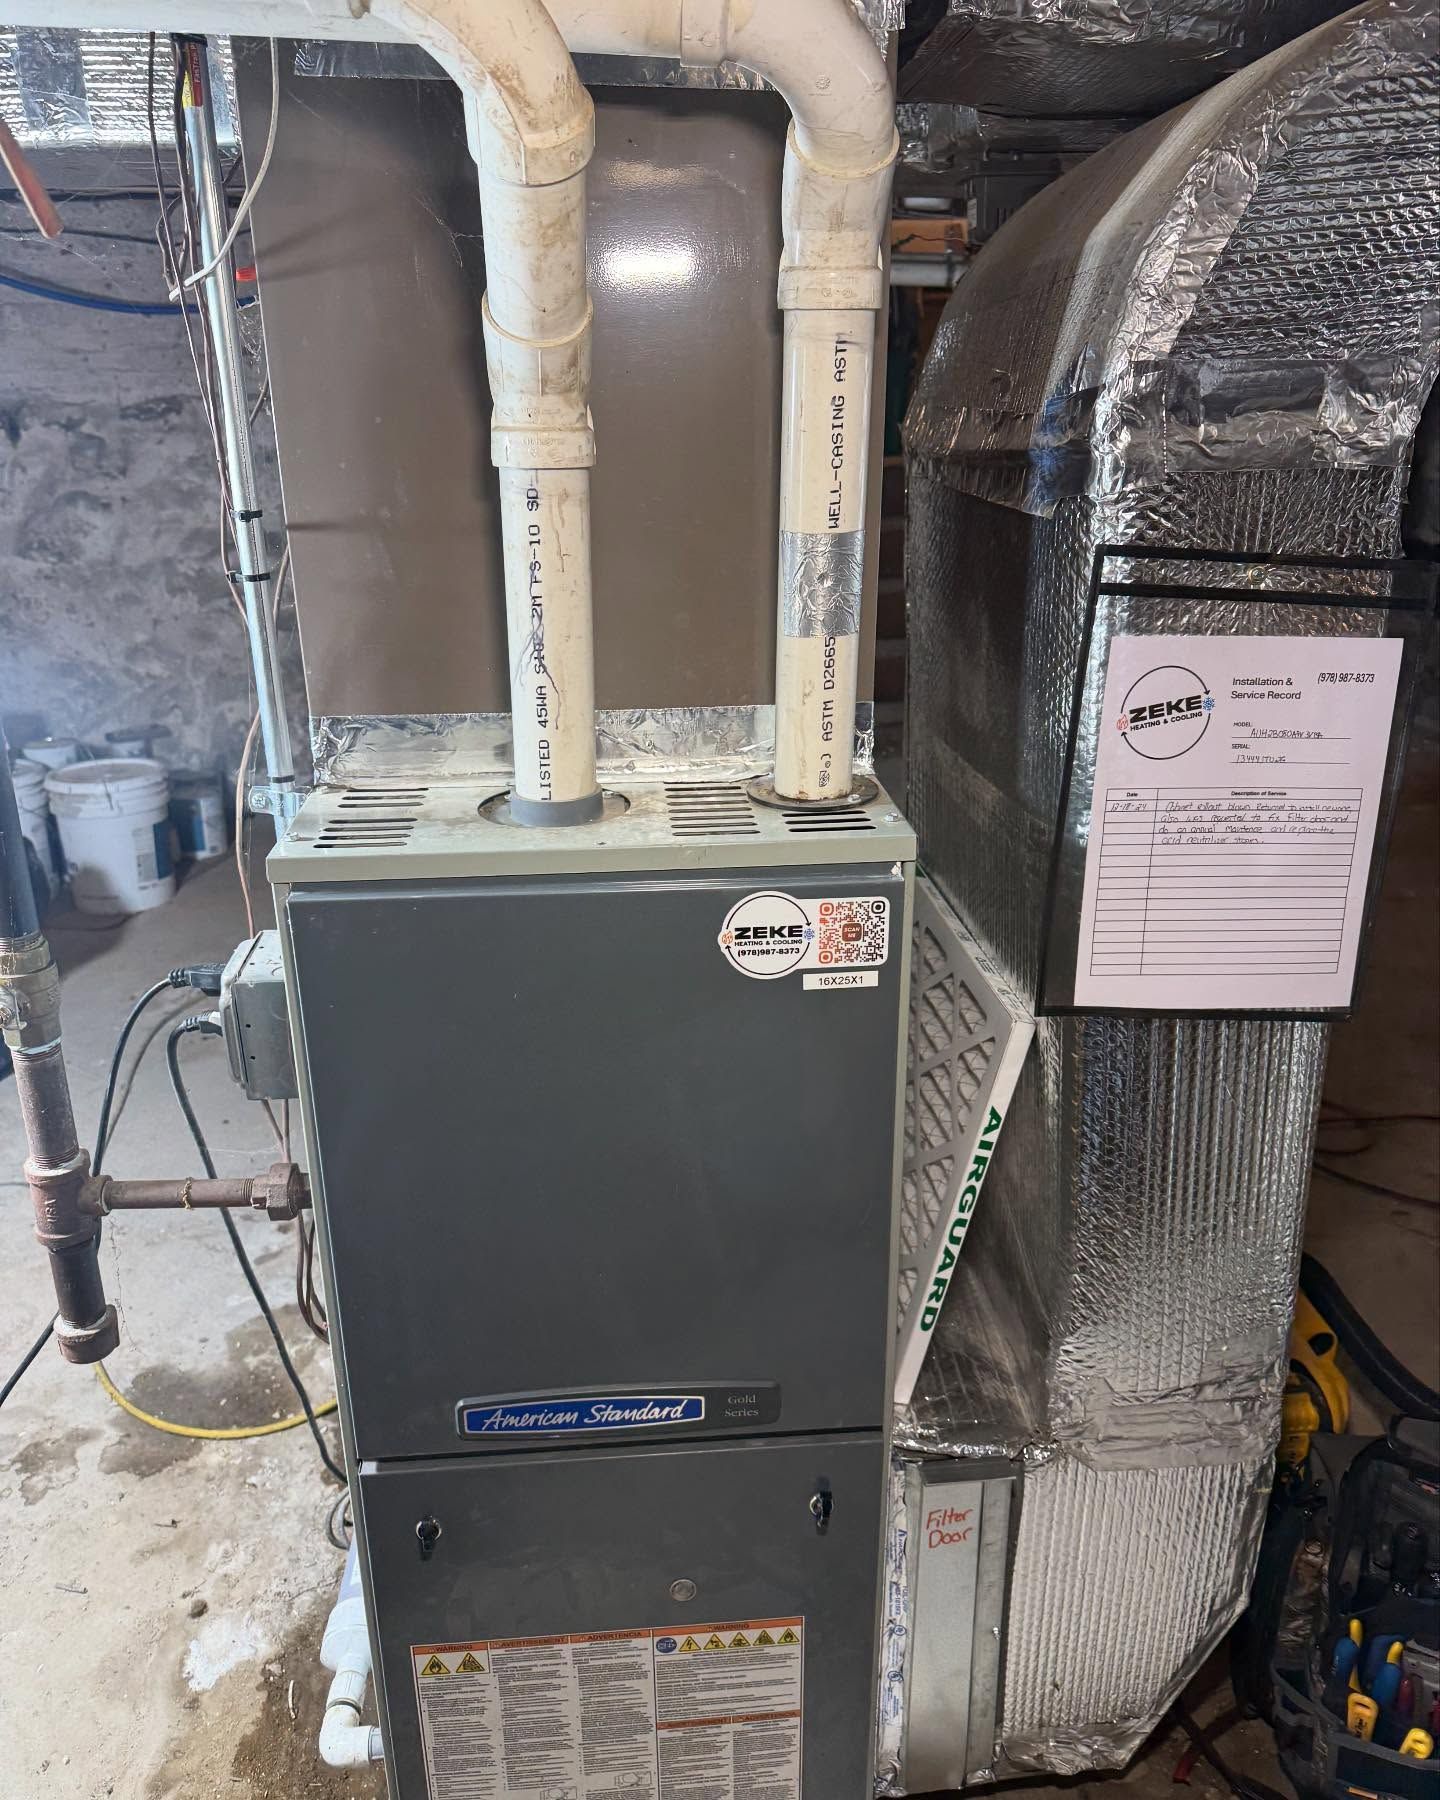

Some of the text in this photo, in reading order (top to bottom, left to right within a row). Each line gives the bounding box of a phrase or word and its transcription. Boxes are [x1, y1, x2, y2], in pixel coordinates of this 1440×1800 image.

[828, 395, 845, 529] WELL-CASING
[528, 524, 542, 584] FS-10
[531, 595, 543, 619] 2M
[823, 636, 836, 690] D2665
[1232, 678, 1293, 686] Installation &
[1317, 672, 1375, 684] (978) 987-8373
[1230, 690, 1301, 700] Service Record
[536, 685, 548, 729] 45WA
[1129, 694, 1202, 723] ZEKE
[822, 700, 834, 742] ASTM
[1130, 719, 1161, 731] HEATING
[1170, 711, 1203, 723] COOLING
[538, 739, 552, 801] LISTED
[1158, 824, 1169, 834] do
[734, 925, 803, 940] ZEKE
[737, 948, 800, 957] (978)987-8373
[818, 975, 864, 986] 16X25X1
[920, 1105, 1002, 1332] AIRGUARD
[727, 1394, 756, 1404] Gold
[481, 1399, 688, 1431] American Standard
[724, 1407, 759, 1417] Series
[926, 1507, 973, 1530] Filter
[928, 1527, 973, 1549] Door
[588, 1632, 642, 1640] ADVERTENCIA
[714, 1623, 750, 1632] WARNING
[436, 1644, 473, 1652] WARNING
[501, 1637, 565, 1648] AVERTISSEMENT
